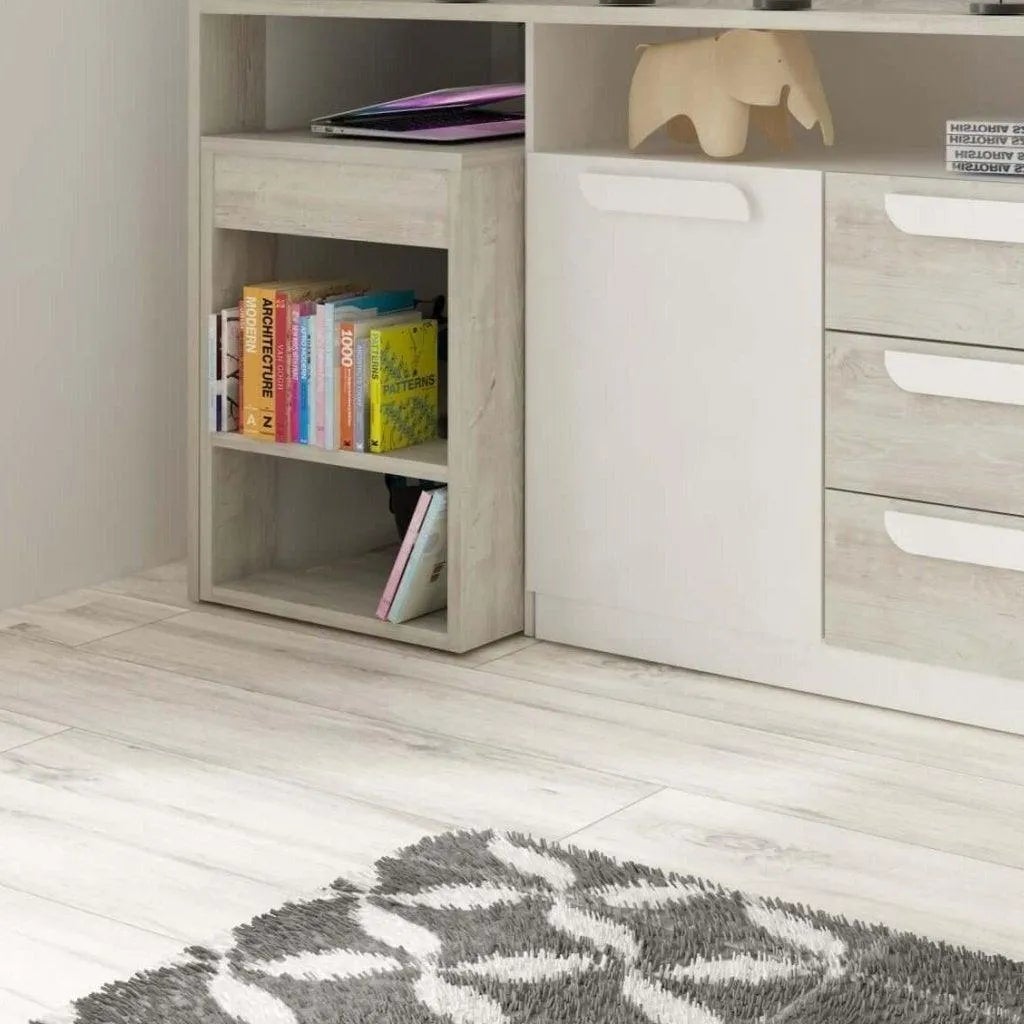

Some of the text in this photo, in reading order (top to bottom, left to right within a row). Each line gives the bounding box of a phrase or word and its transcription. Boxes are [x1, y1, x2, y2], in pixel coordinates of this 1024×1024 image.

[246, 296, 257, 353] MODERN
[262, 298, 273, 399] ARCHITECTURE
[340, 328, 353, 368] 1000
[370, 330, 380, 380] PATTERNS
[383, 375, 435, 395] PATTERNS
[247, 414, 272, 428] A Z
